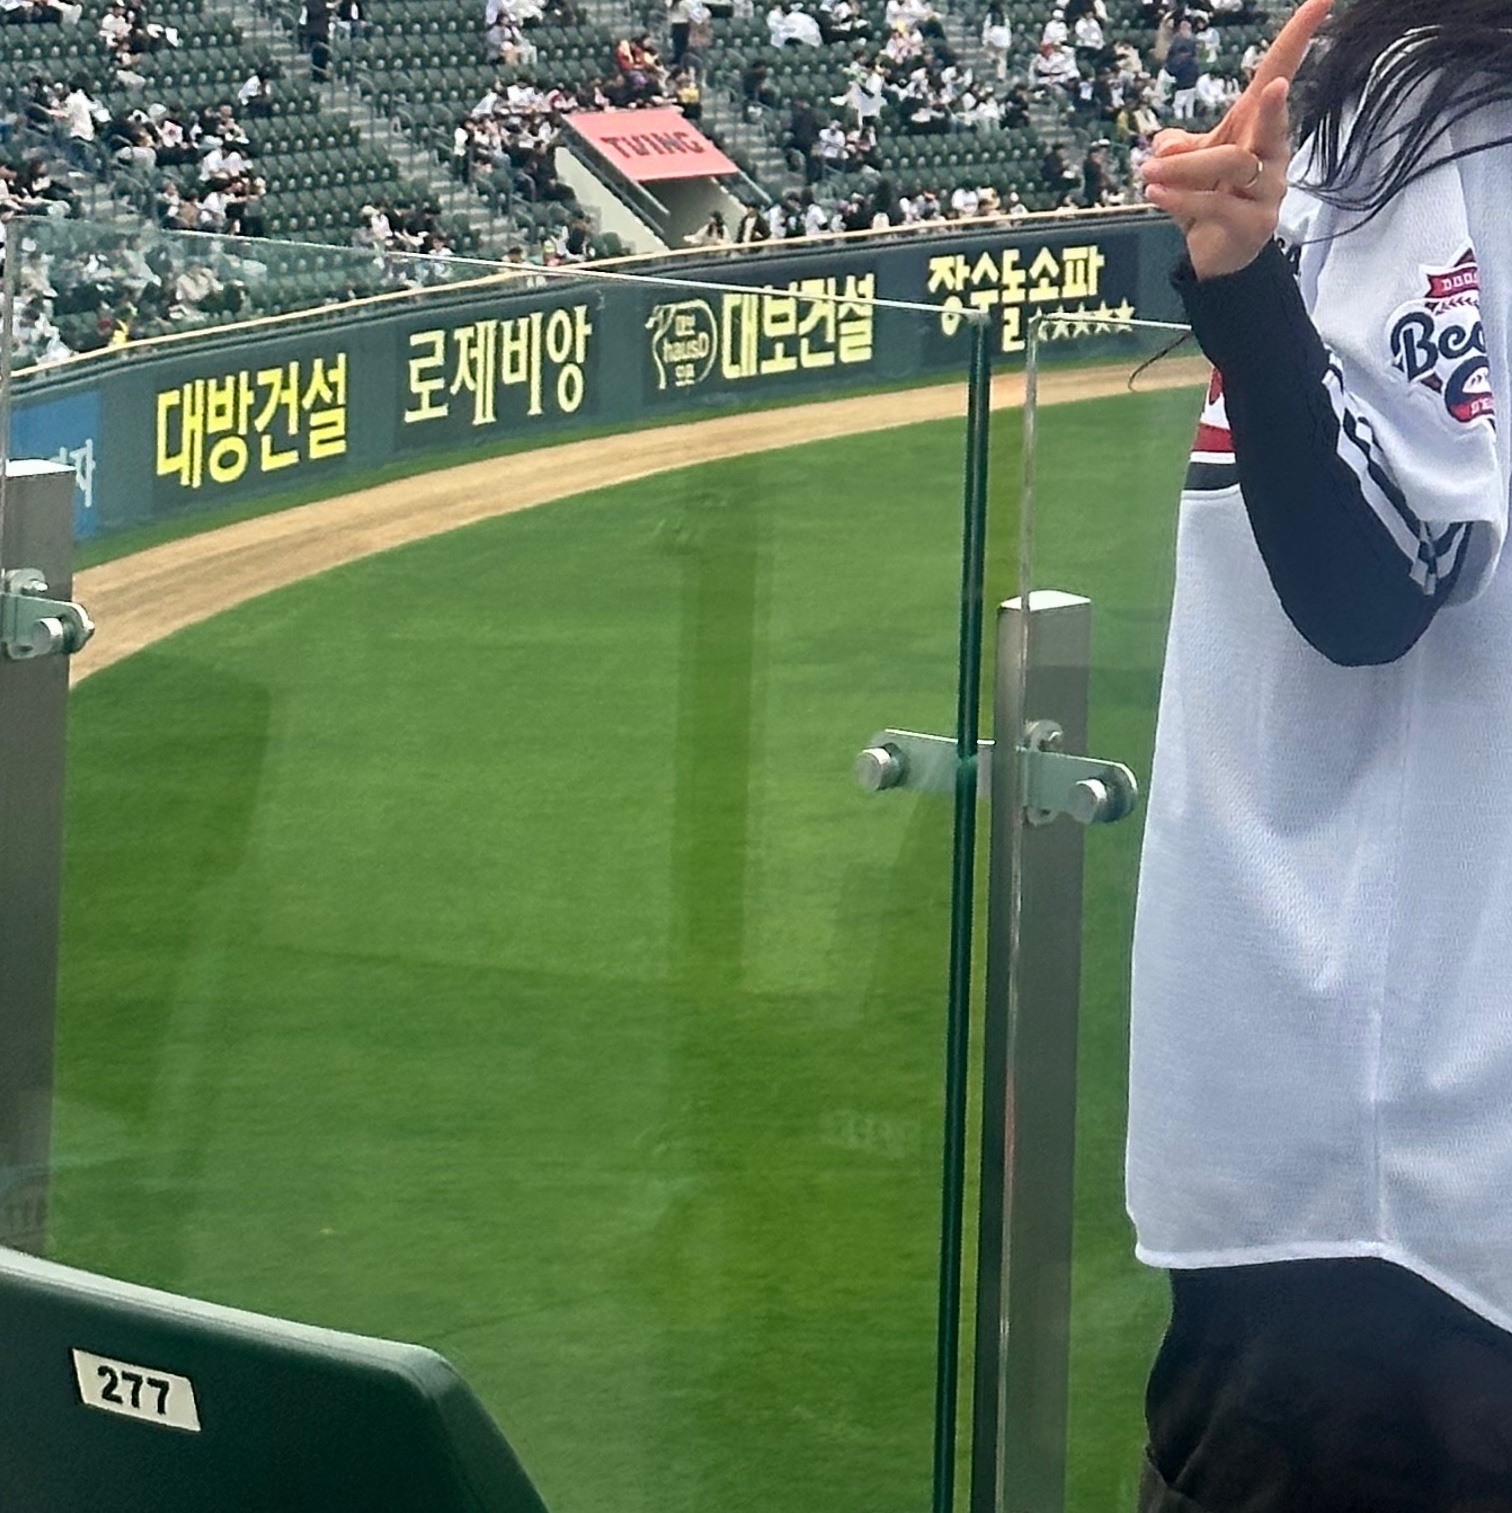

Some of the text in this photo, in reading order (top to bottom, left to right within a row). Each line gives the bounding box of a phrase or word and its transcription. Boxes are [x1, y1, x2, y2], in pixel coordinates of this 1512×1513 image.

[600, 131, 704, 159] TVING
[404, 304, 592, 426] 로제비앙
[722, 273, 875, 379] 대보건설
[157, 353, 347, 488] 대방건설
[97, 1364, 170, 1415] 277
